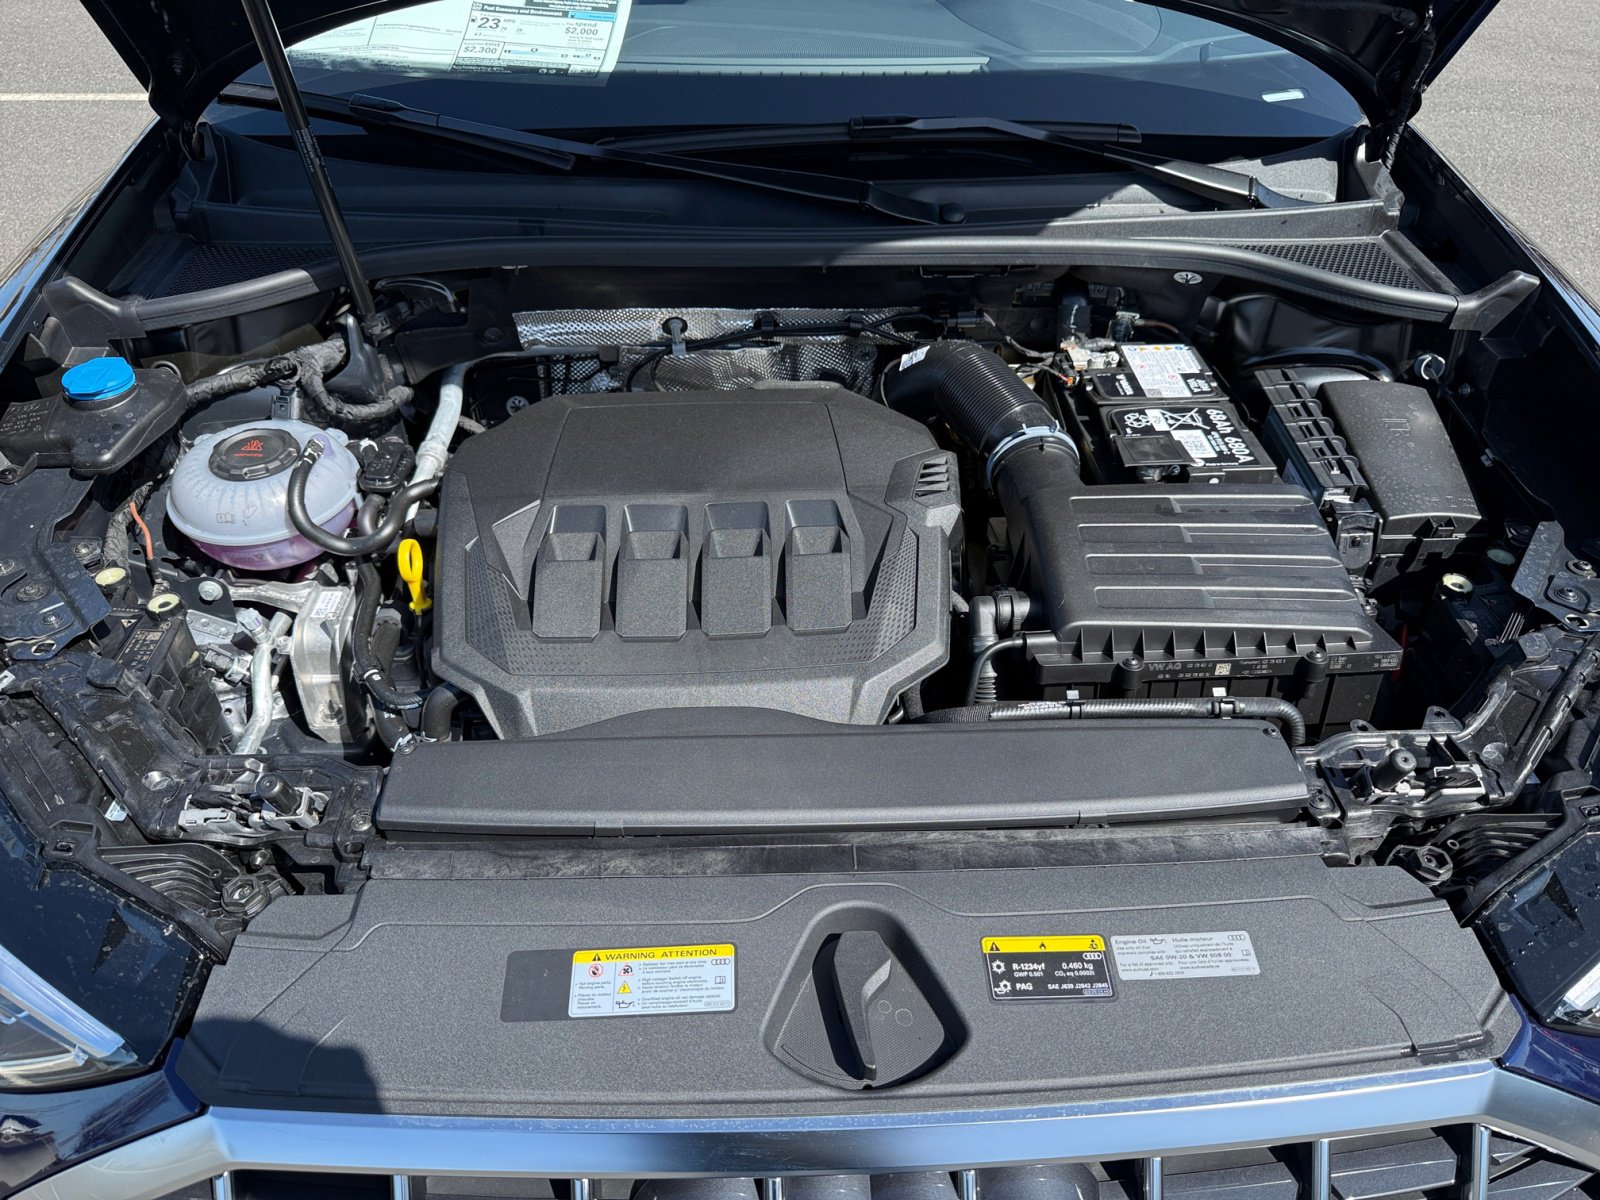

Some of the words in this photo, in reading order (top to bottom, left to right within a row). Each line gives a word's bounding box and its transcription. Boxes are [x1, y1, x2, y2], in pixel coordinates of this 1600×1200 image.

[478, 17, 501, 29] 23
[564, 27, 598, 35] $2,000
[464, 46, 497, 54] $2,300
[1206, 409, 1234, 433] 68Ah
[1224, 437, 1254, 463] 680A
[1148, 663, 1166, 671] VW
[605, 951, 655, 961] WARNING
[661, 949, 717, 958] ATTENTION
[1012, 962, 1045, 971] R-1234yf
[1084, 962, 1093, 970] kg
